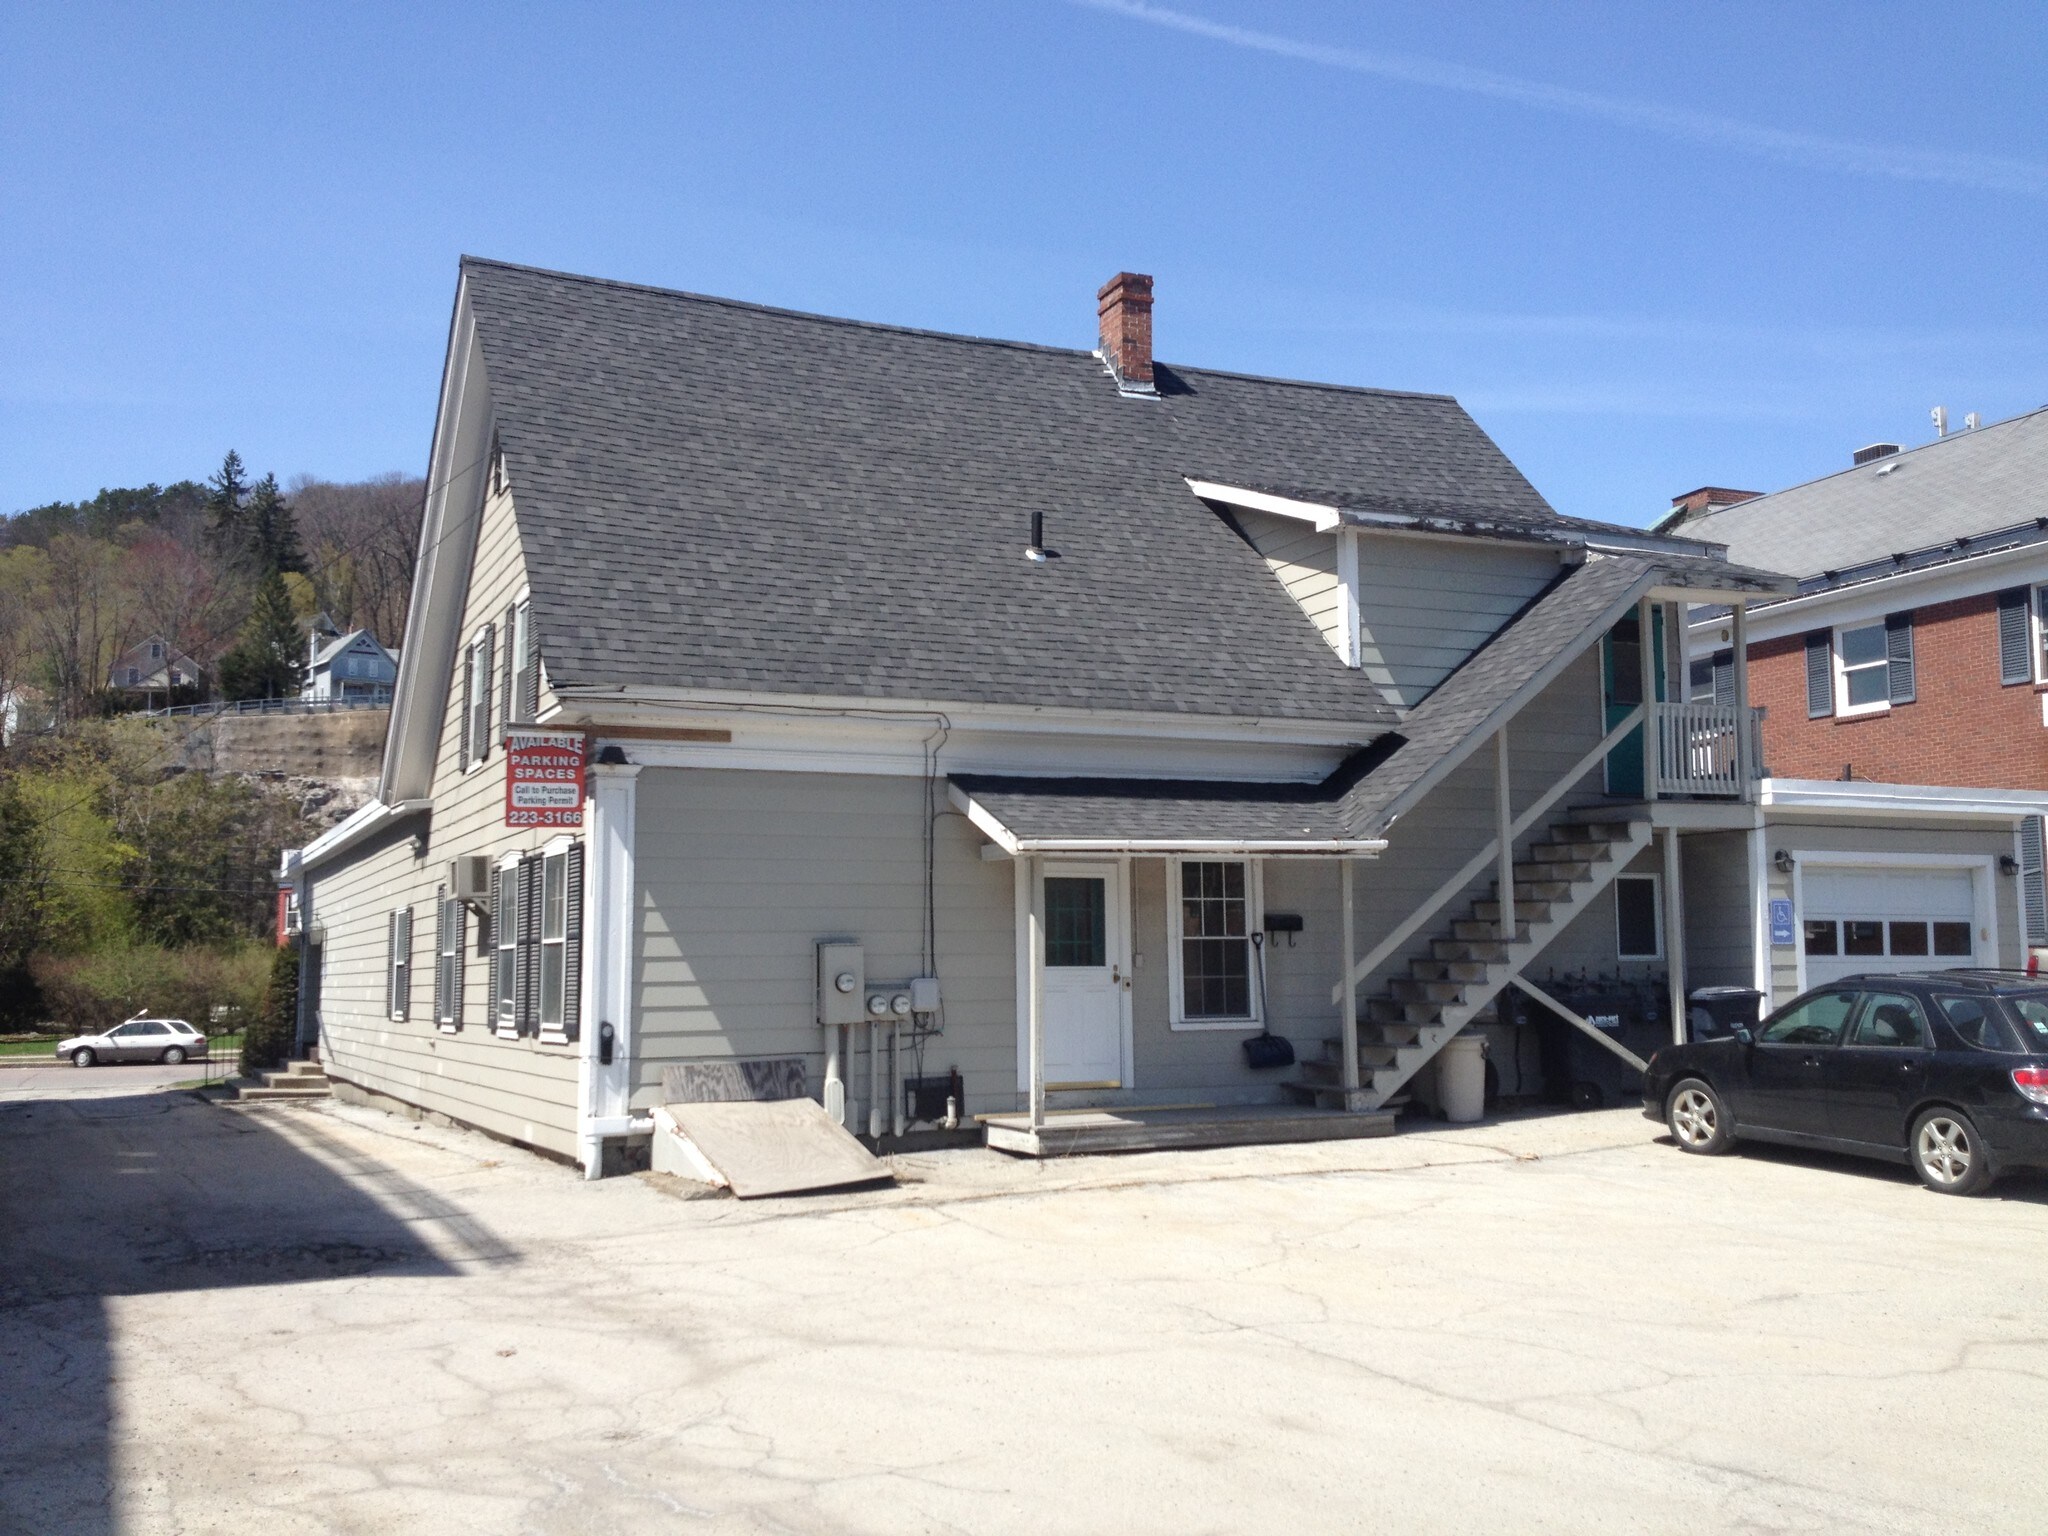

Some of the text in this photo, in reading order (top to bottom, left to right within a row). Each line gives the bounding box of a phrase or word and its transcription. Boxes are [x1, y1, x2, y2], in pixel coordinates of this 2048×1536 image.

[509, 736, 583, 755] AVAILABLE
[511, 755, 580, 766] PARKING
[514, 768, 576, 779] SPACES
[515, 785, 577, 795] Call to Purchase
[518, 796, 574, 806] Parking Permit
[509, 811, 582, 824] 223-3166
